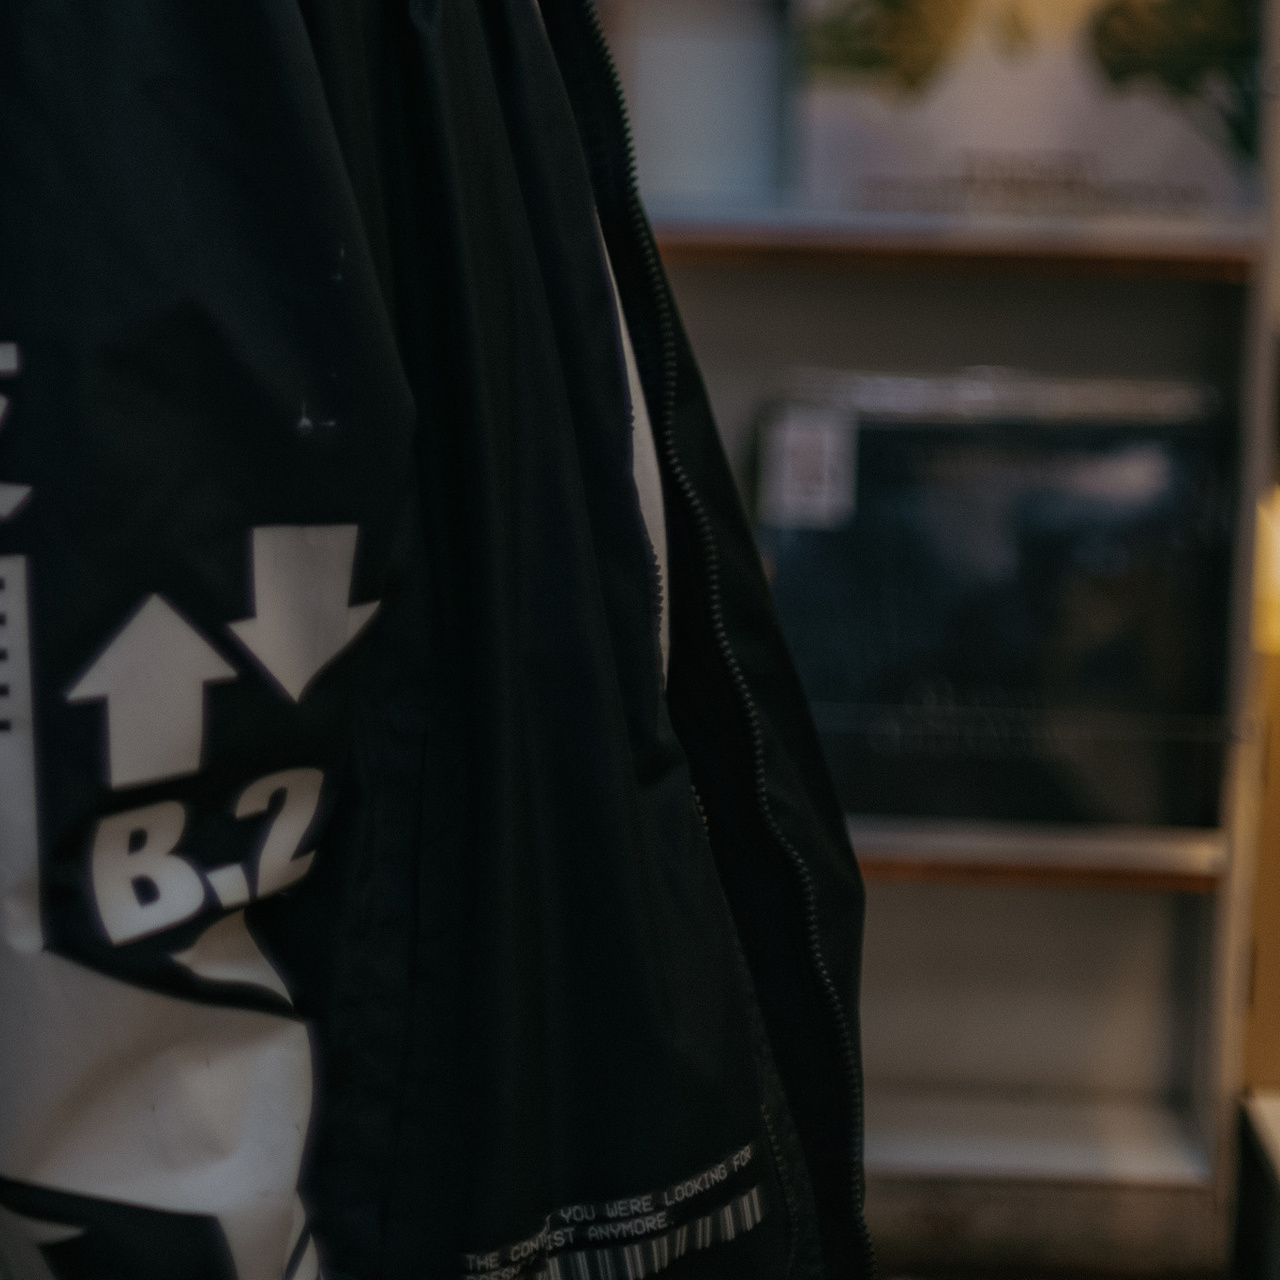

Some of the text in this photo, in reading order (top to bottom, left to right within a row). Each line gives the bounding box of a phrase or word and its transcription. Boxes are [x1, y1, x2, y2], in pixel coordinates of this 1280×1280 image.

[91, 767, 324, 945] B.2
[465, 1251, 500, 1271] THE
[560, 1204, 596, 1223] YOU
[606, 1194, 654, 1218] WERE
[664, 1163, 728, 1207] LOOKING
[732, 1144, 752, 1172] FOR
